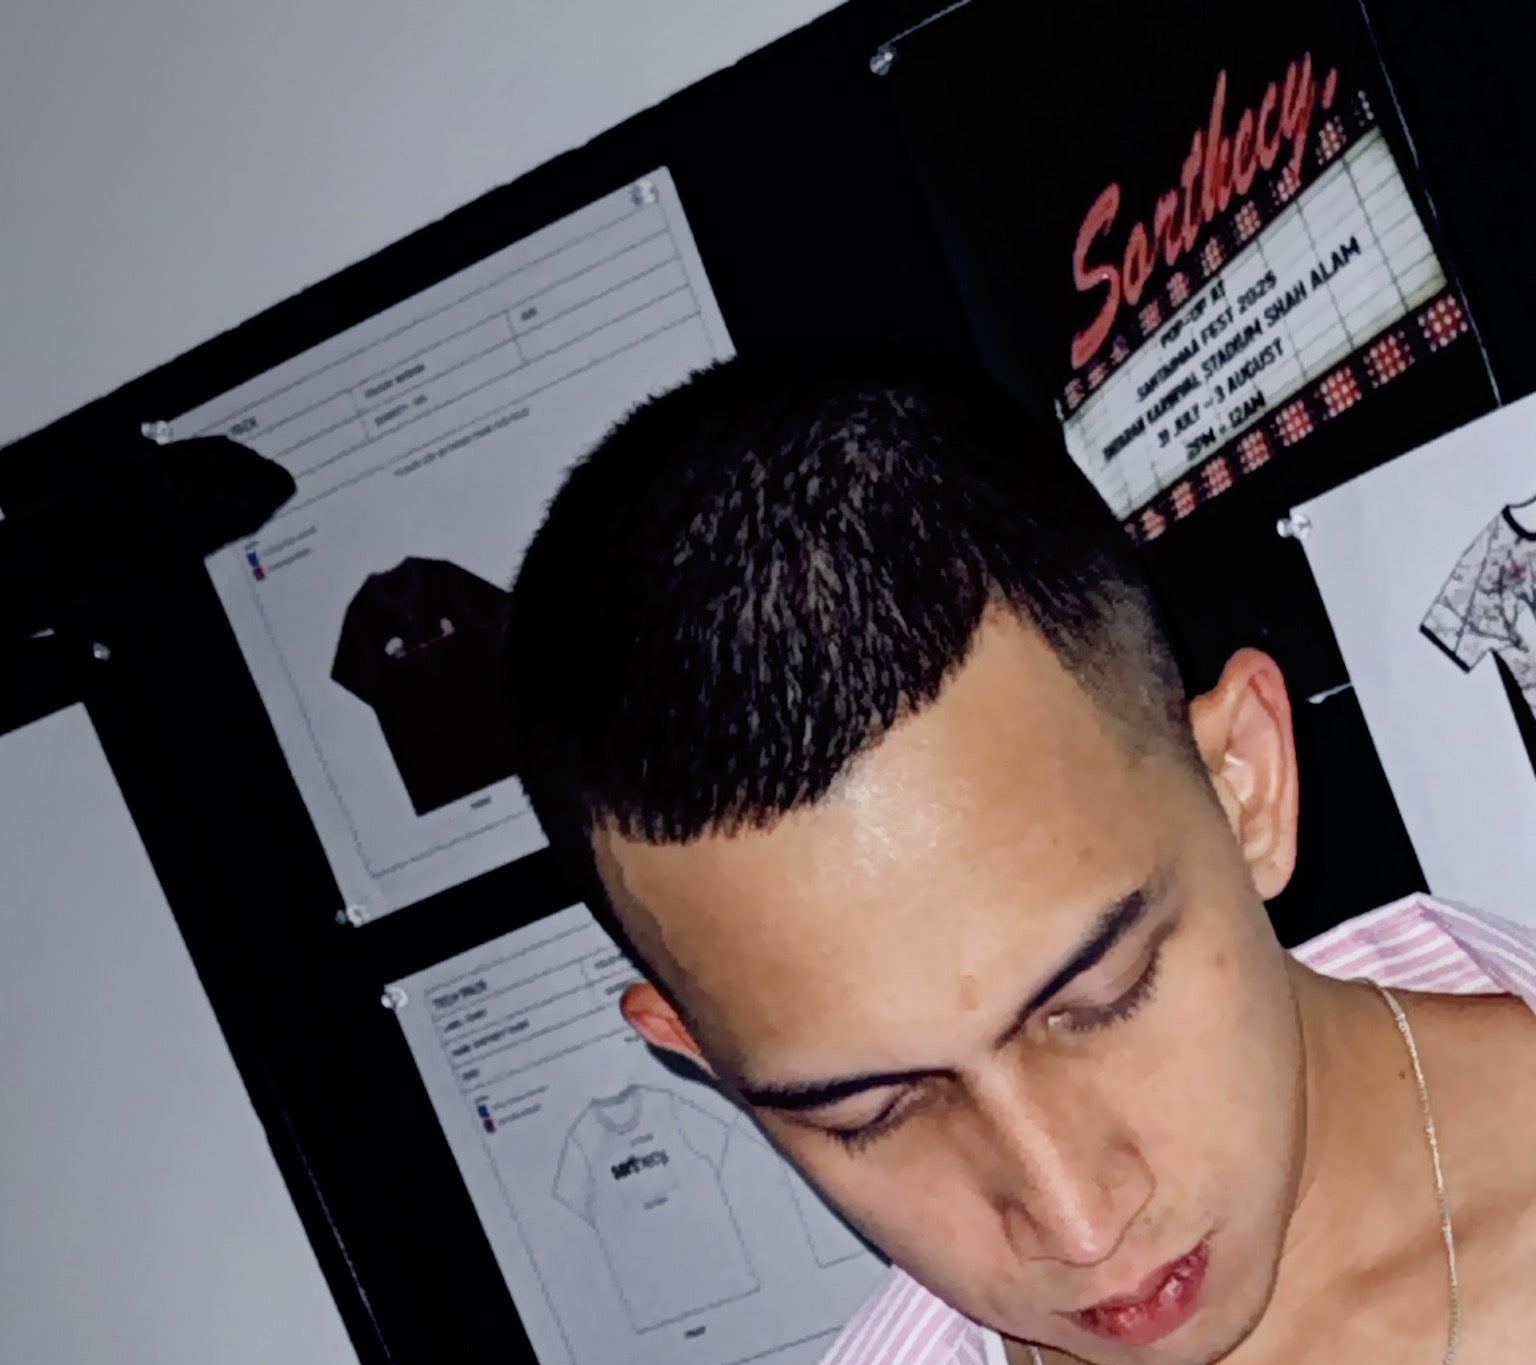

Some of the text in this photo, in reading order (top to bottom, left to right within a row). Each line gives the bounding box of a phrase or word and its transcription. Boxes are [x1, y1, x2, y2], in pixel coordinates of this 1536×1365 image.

[1071, 50, 1338, 369] Sorthecy.
[1202, 320, 1263, 379] STADIUM
[1265, 283, 1307, 326] SHAH
[1311, 236, 1362, 291] ALAM
[1202, 307, 1235, 346] FEST
[1238, 270, 1277, 313] 2025
[1215, 385, 1226, 405] 3
[1227, 337, 1284, 393] AUGUST
[1228, 391, 1267, 425] 12AM
